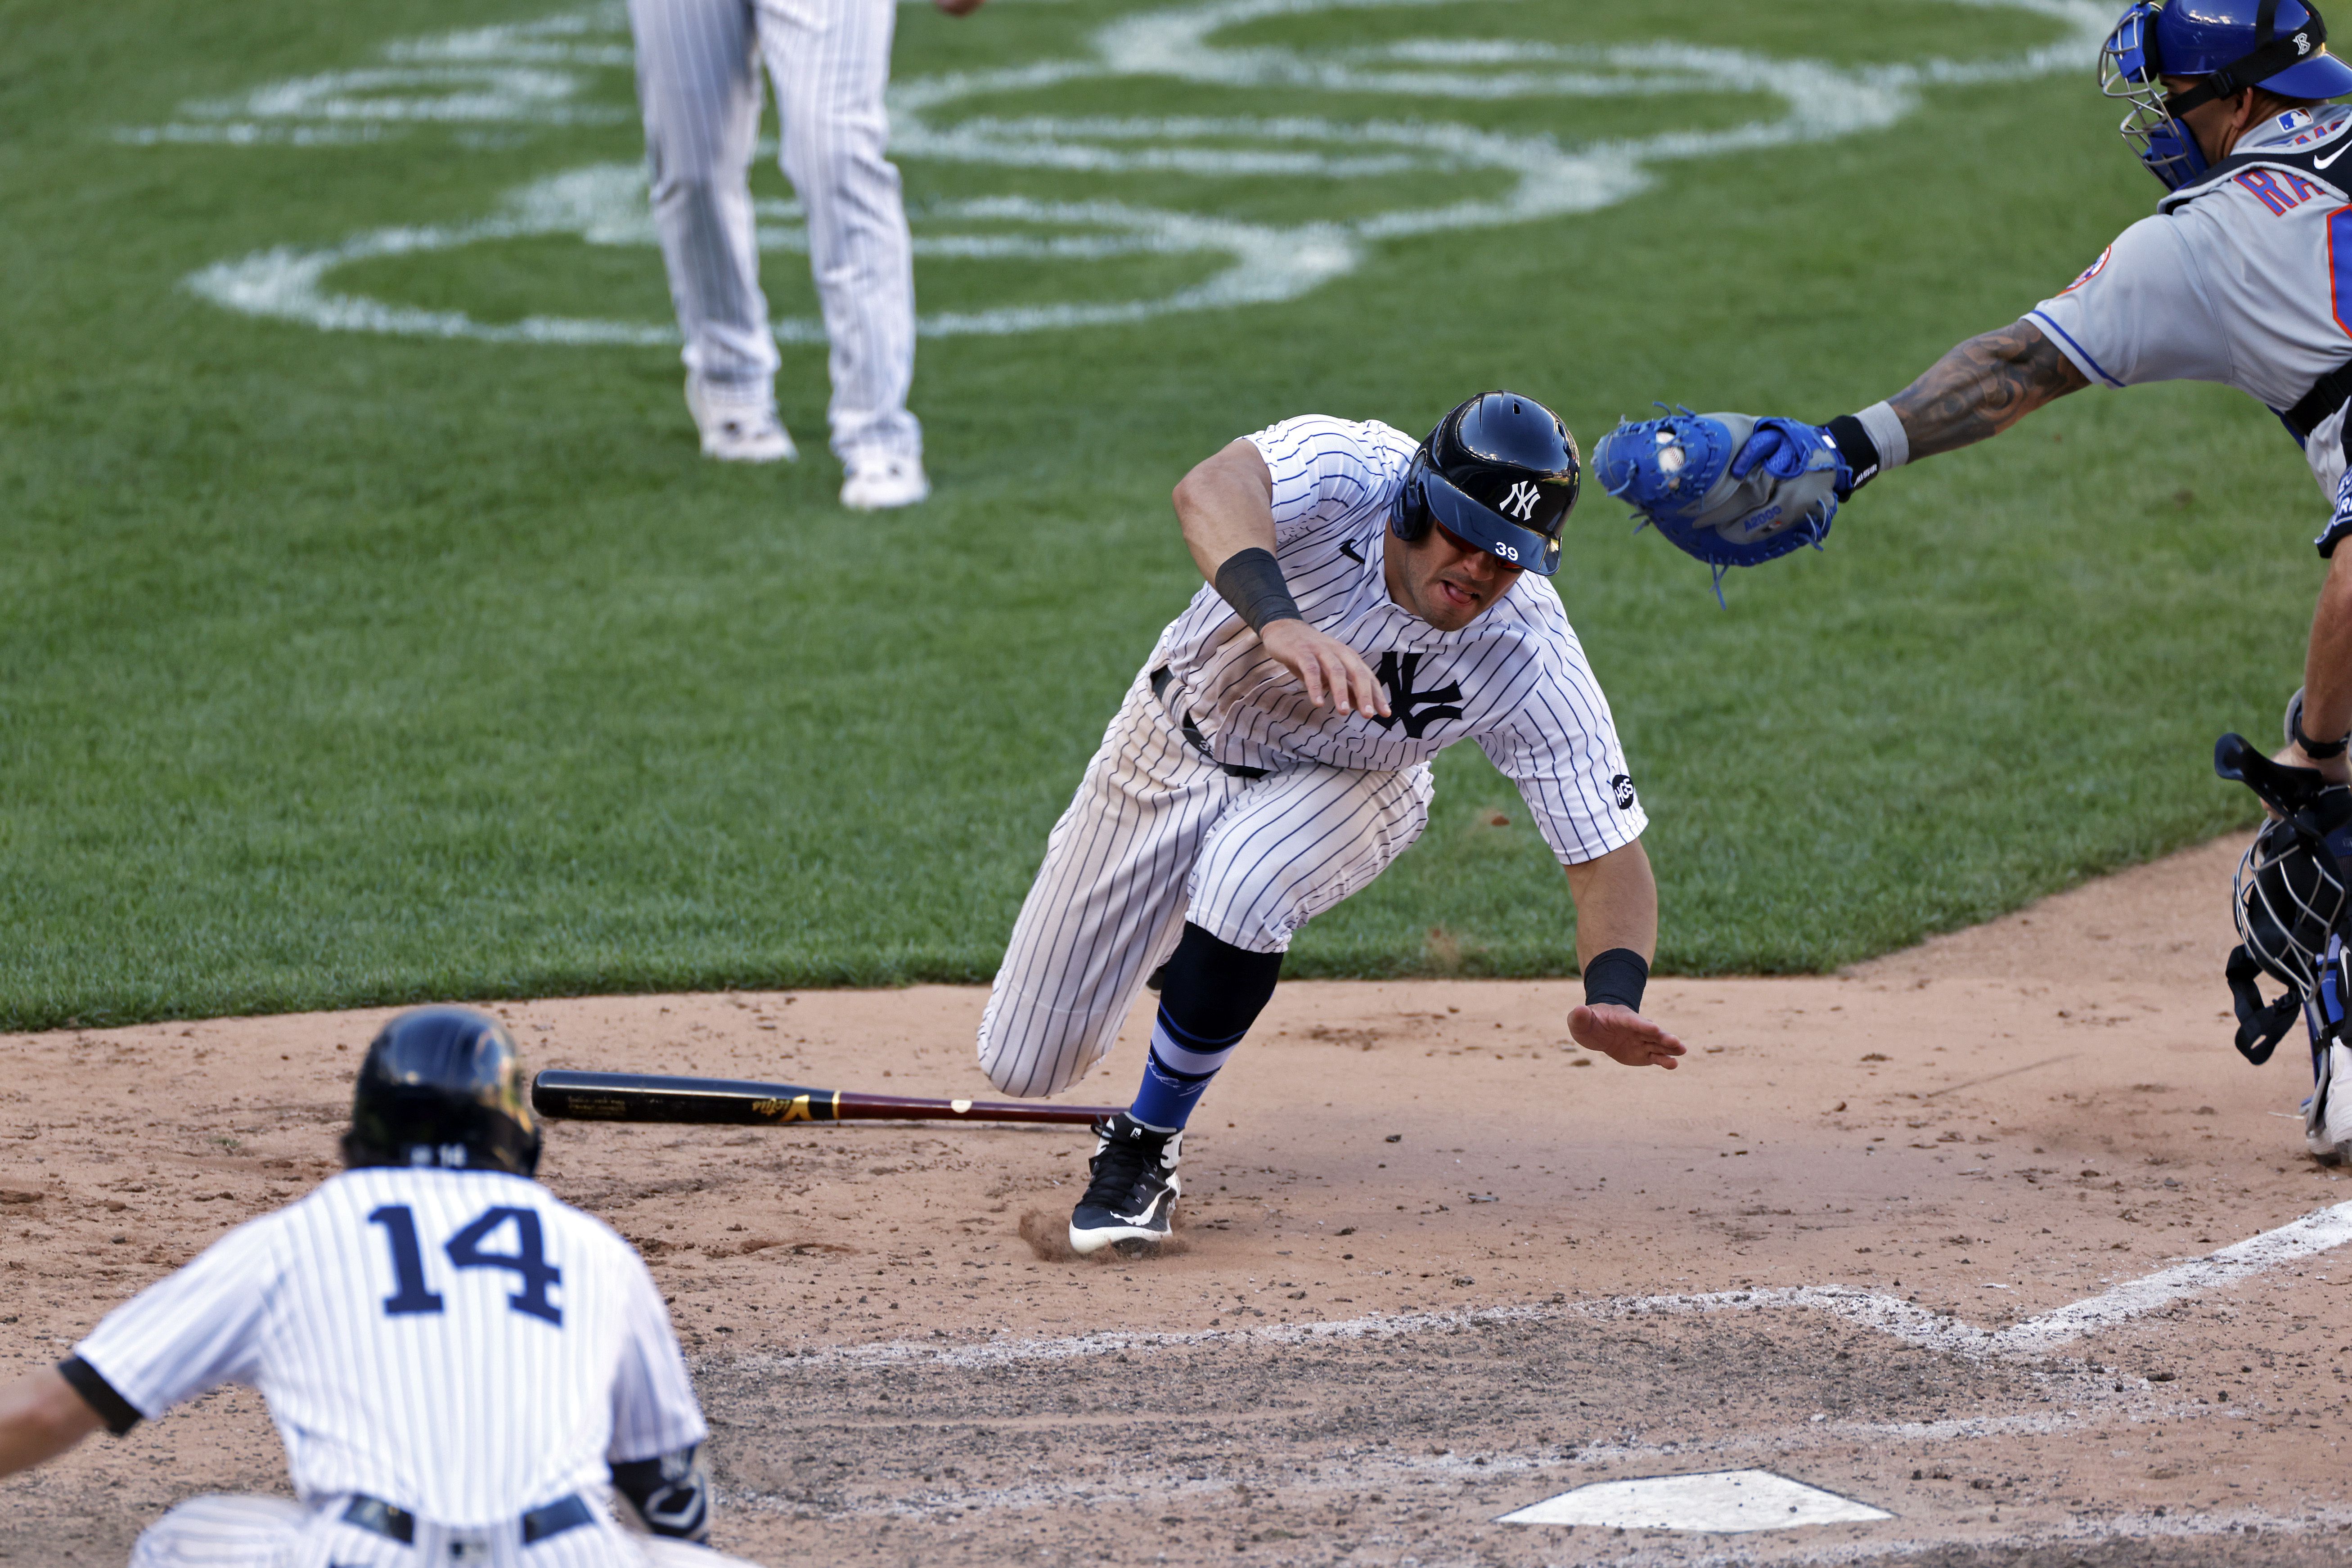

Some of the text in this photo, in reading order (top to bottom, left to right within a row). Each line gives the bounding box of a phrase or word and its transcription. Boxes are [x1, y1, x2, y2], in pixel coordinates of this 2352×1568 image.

[1499, 481, 1541, 521] NY
[1495, 542, 1519, 561] 39
[1614, 778, 1633, 805] HGS
[368, 1204, 562, 1328] 14
